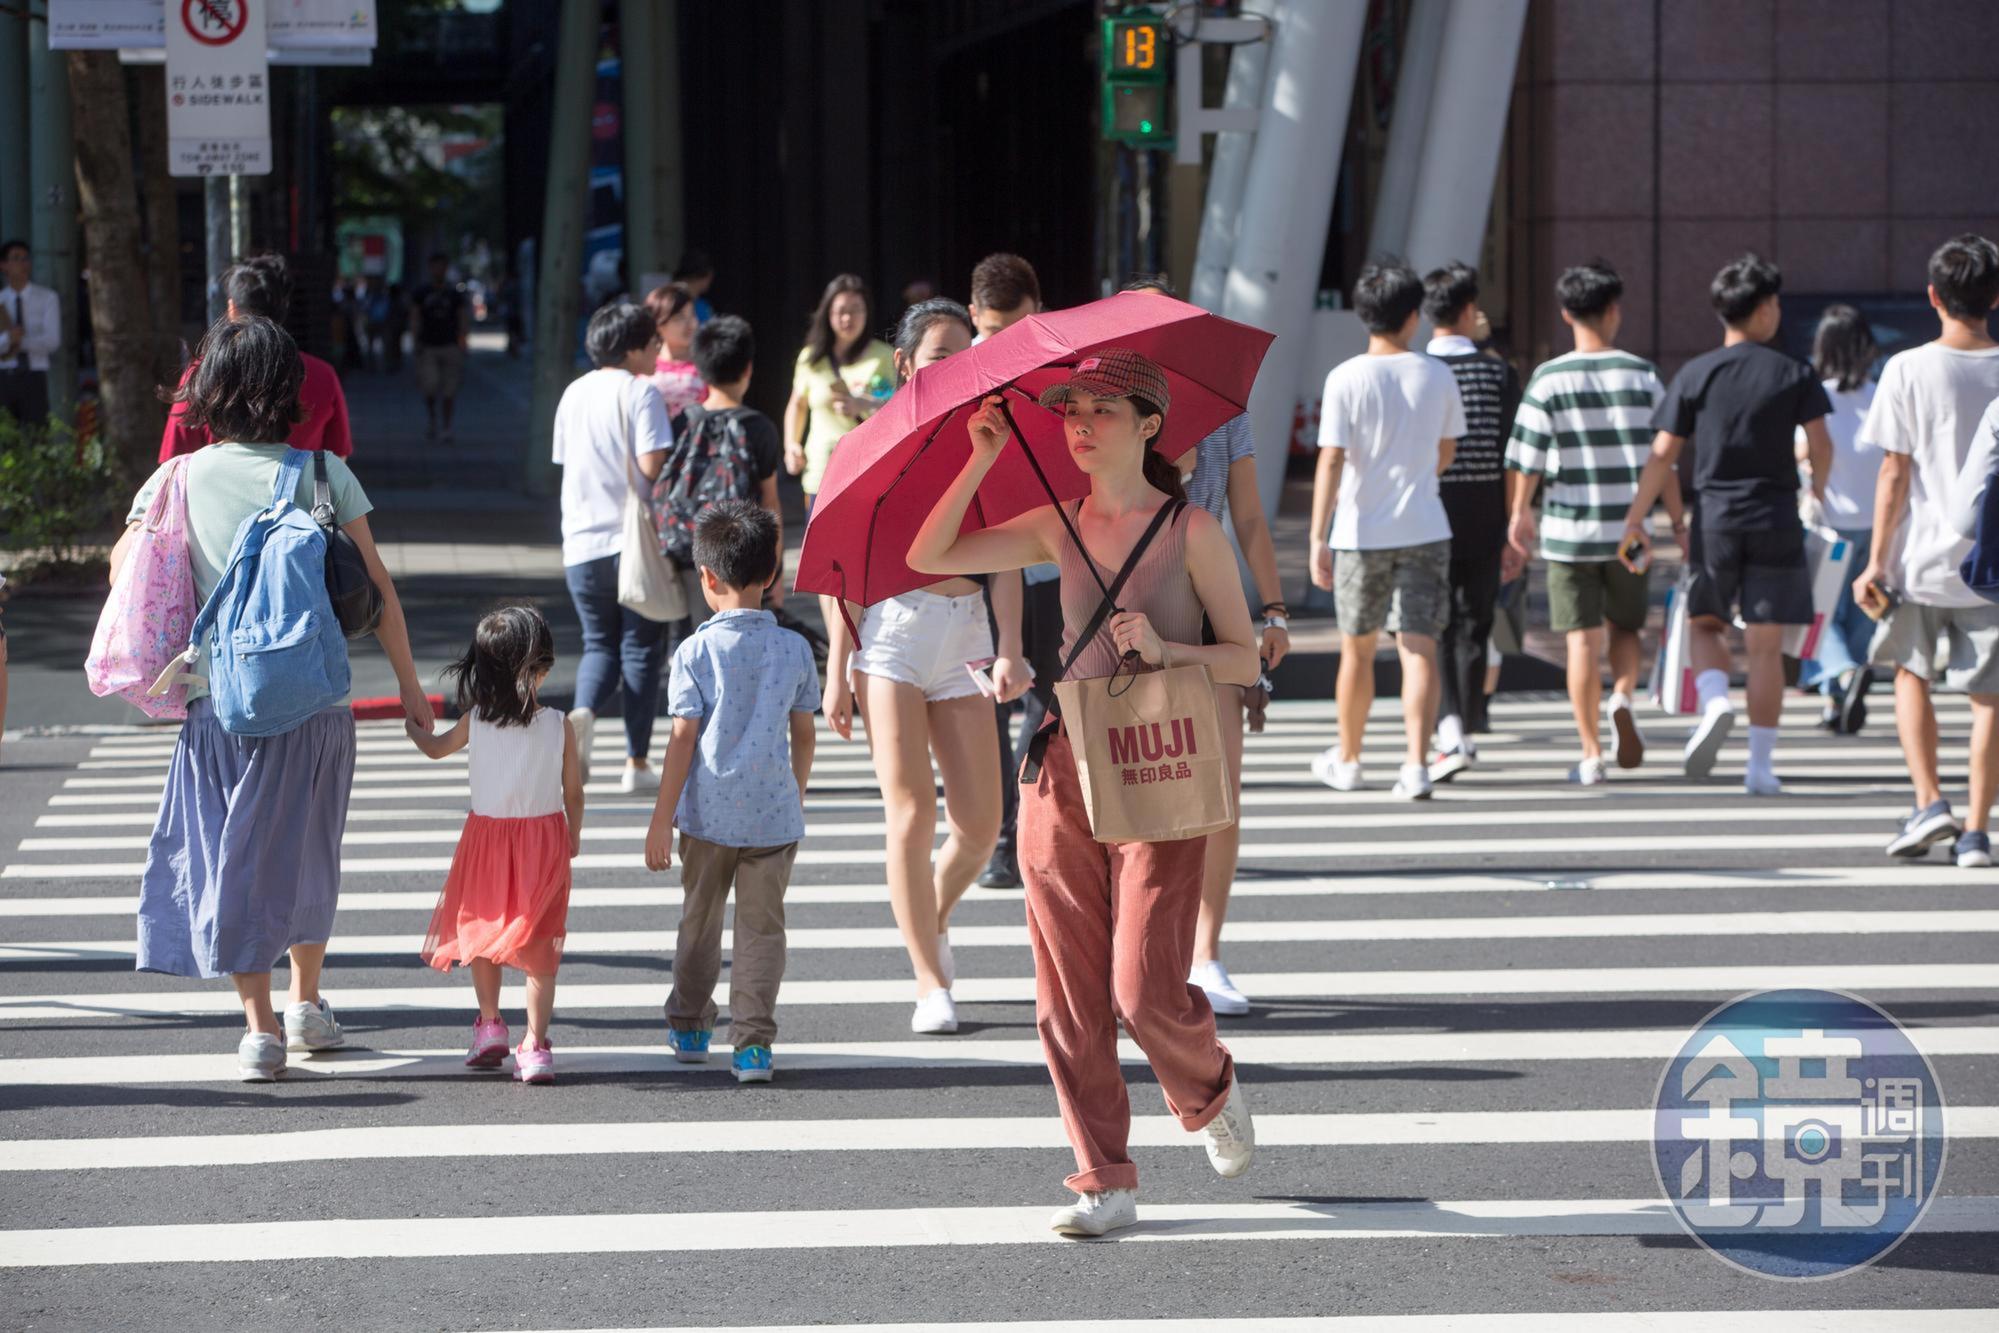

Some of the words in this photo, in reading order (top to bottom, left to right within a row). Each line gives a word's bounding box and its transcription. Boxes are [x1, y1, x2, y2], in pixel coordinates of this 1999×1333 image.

[1125, 25, 1155, 69] 13
[172, 74, 263, 90] 行人徒步區
[188, 93, 264, 106] SIDEWALK
[1108, 717, 1197, 765] MUJI
[1121, 761, 1192, 786] 無印良品
